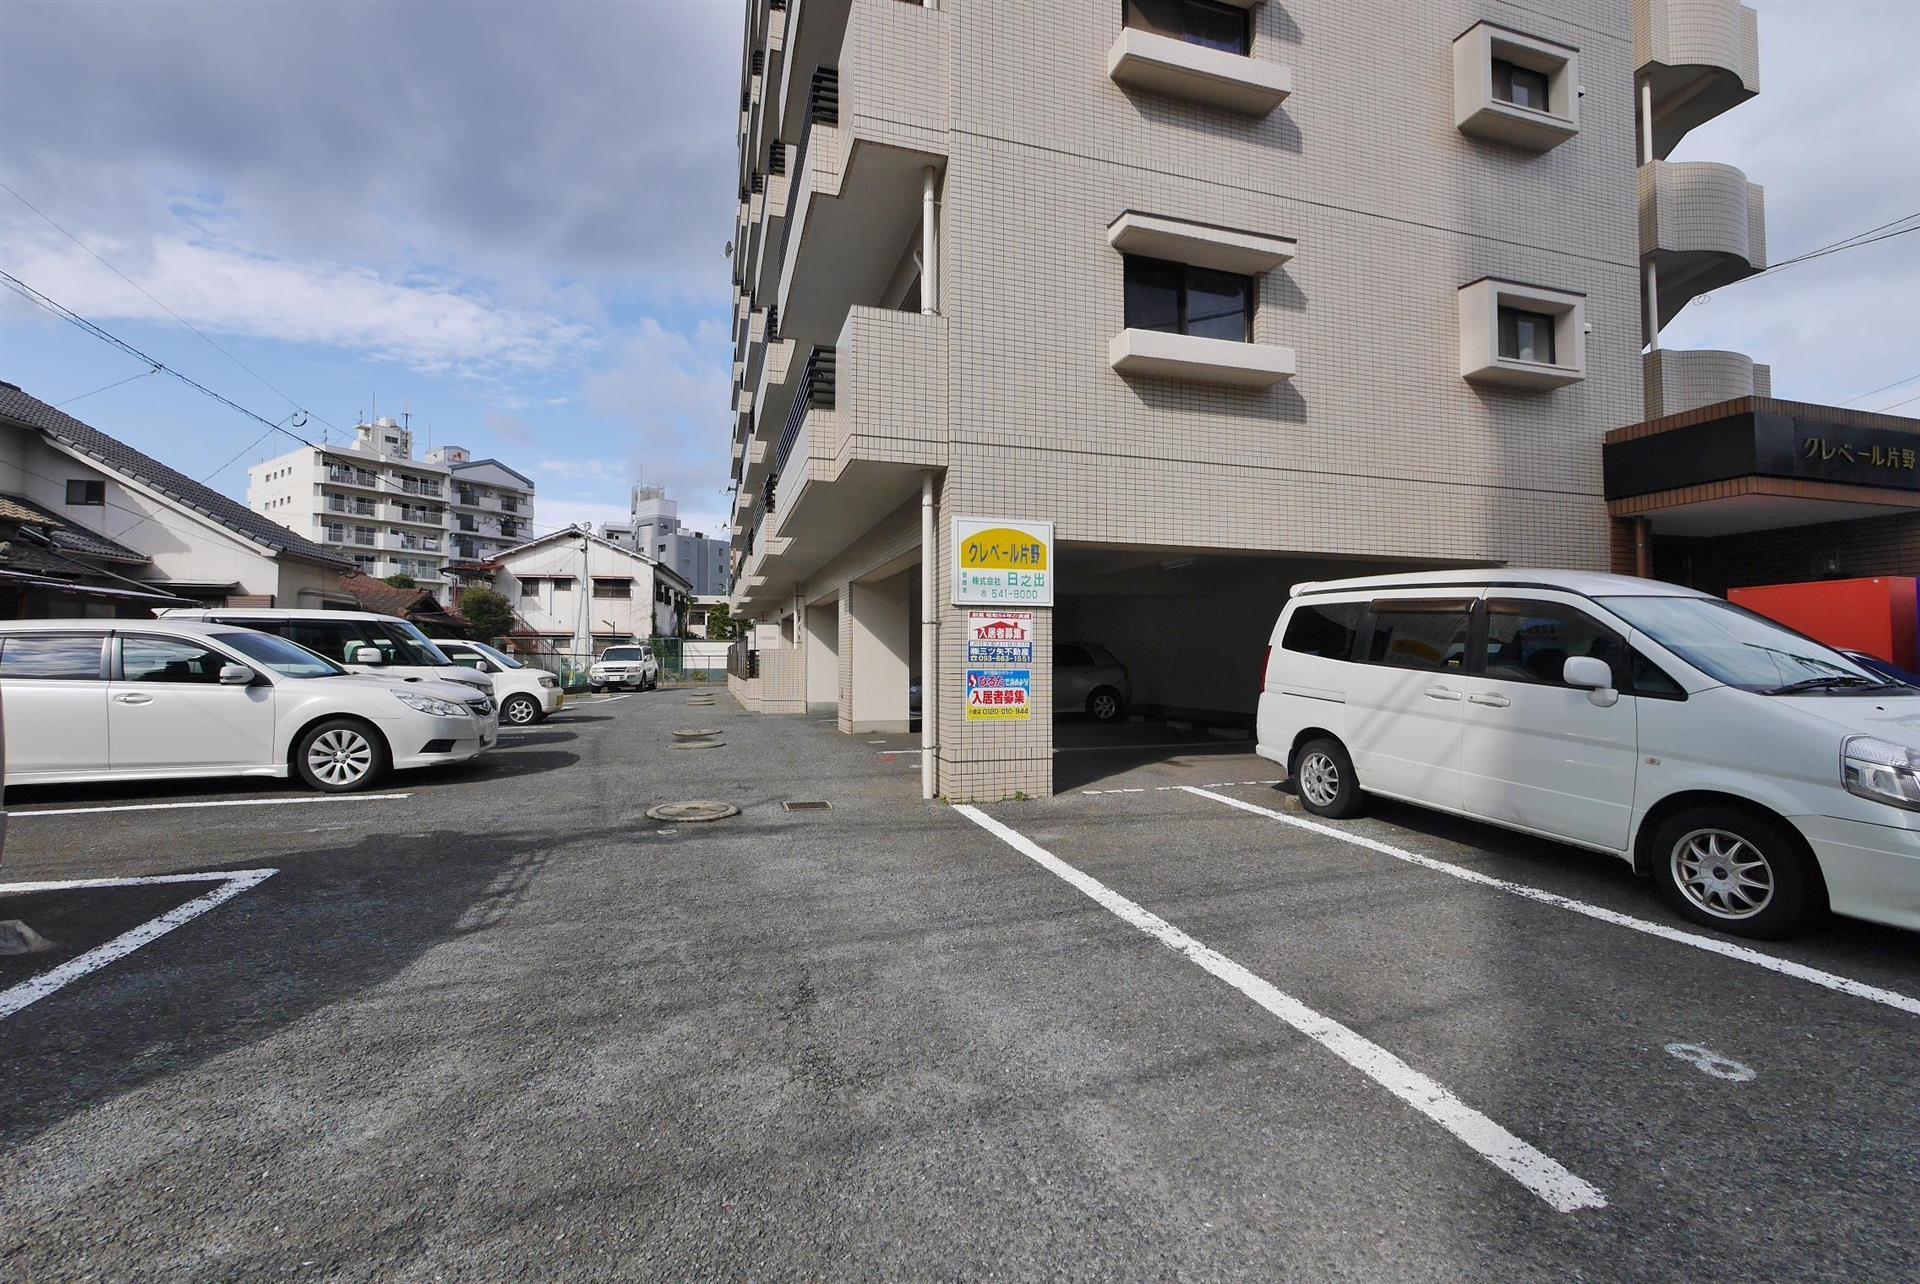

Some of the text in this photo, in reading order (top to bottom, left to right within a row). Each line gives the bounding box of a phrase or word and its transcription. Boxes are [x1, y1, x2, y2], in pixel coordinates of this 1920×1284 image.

[1805, 438, 1915, 469] クレベール片野
[969, 542, 1040, 565] クレベール片野
[972, 572, 1045, 587] 株式会社 日之出
[992, 589, 1038, 599] 541-8000
[979, 627, 1022, 639] 入居者募集
[972, 690, 1025, 704] 入居者募集
